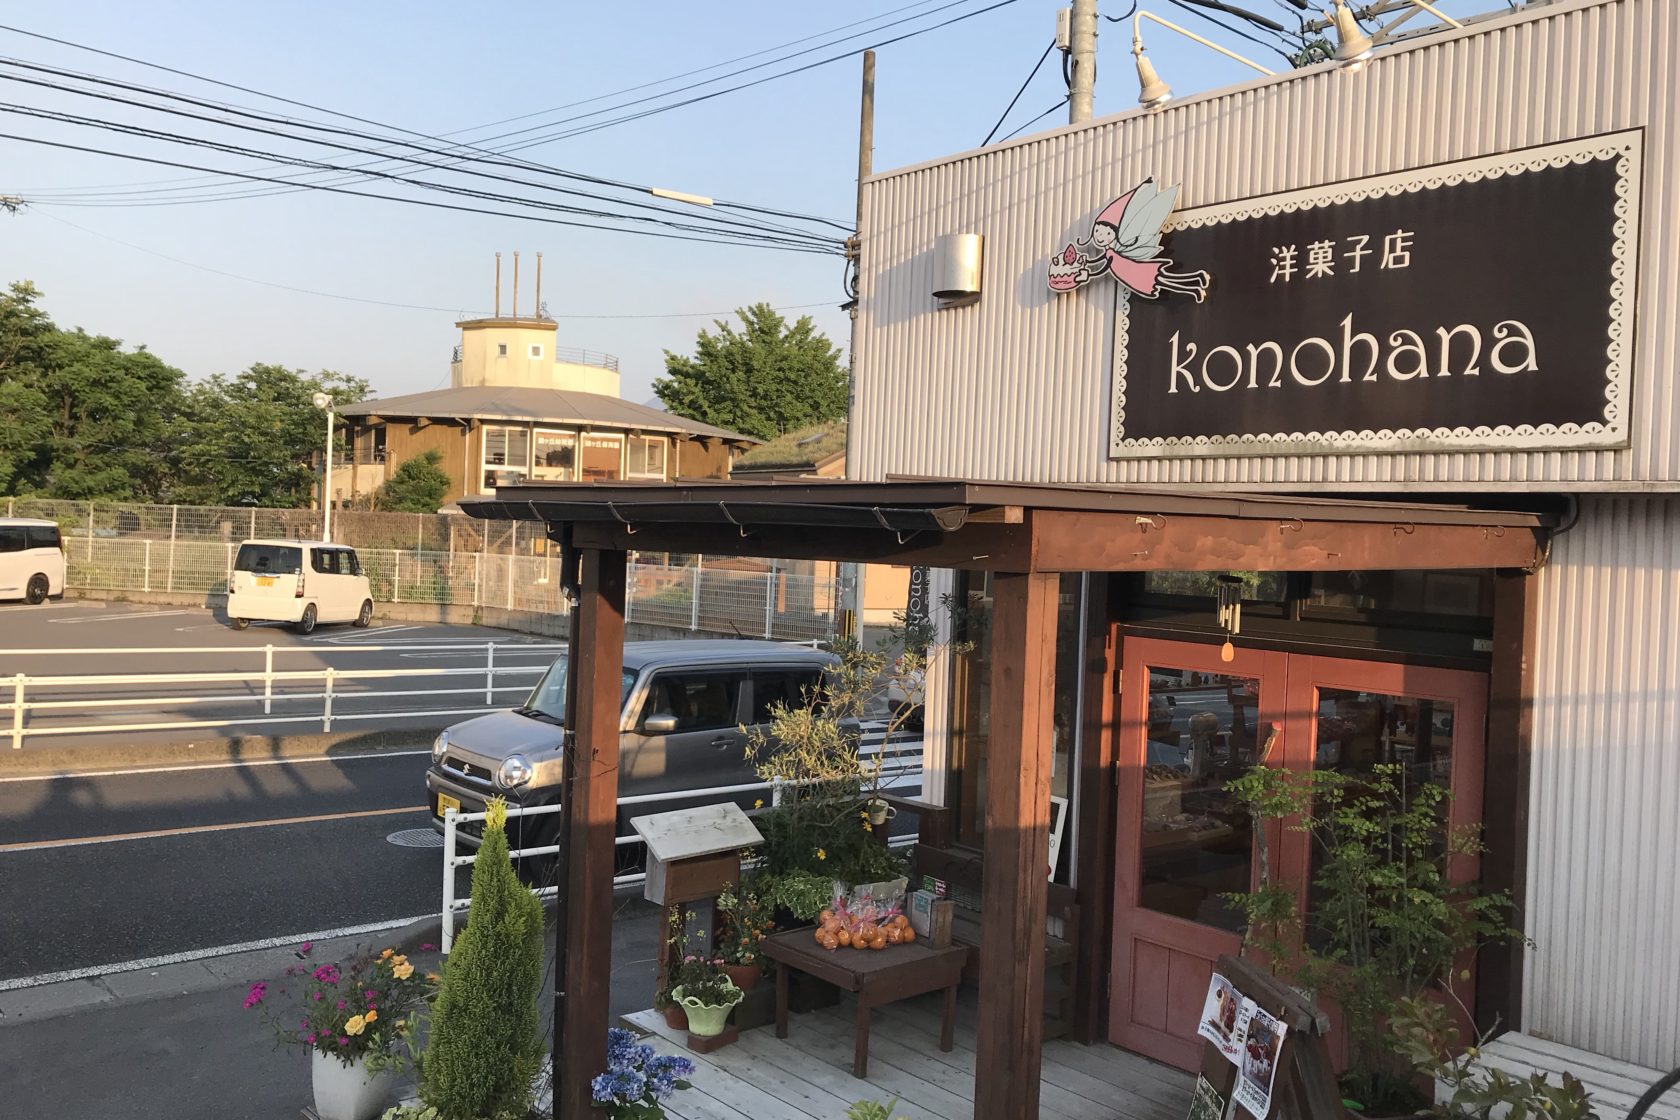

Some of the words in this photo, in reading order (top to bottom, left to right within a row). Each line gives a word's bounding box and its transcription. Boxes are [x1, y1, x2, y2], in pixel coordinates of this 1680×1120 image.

[1268, 228, 1416, 284] 洋菓子店
[1166, 311, 1540, 395] konohana
[909, 566, 924, 633] onoh
